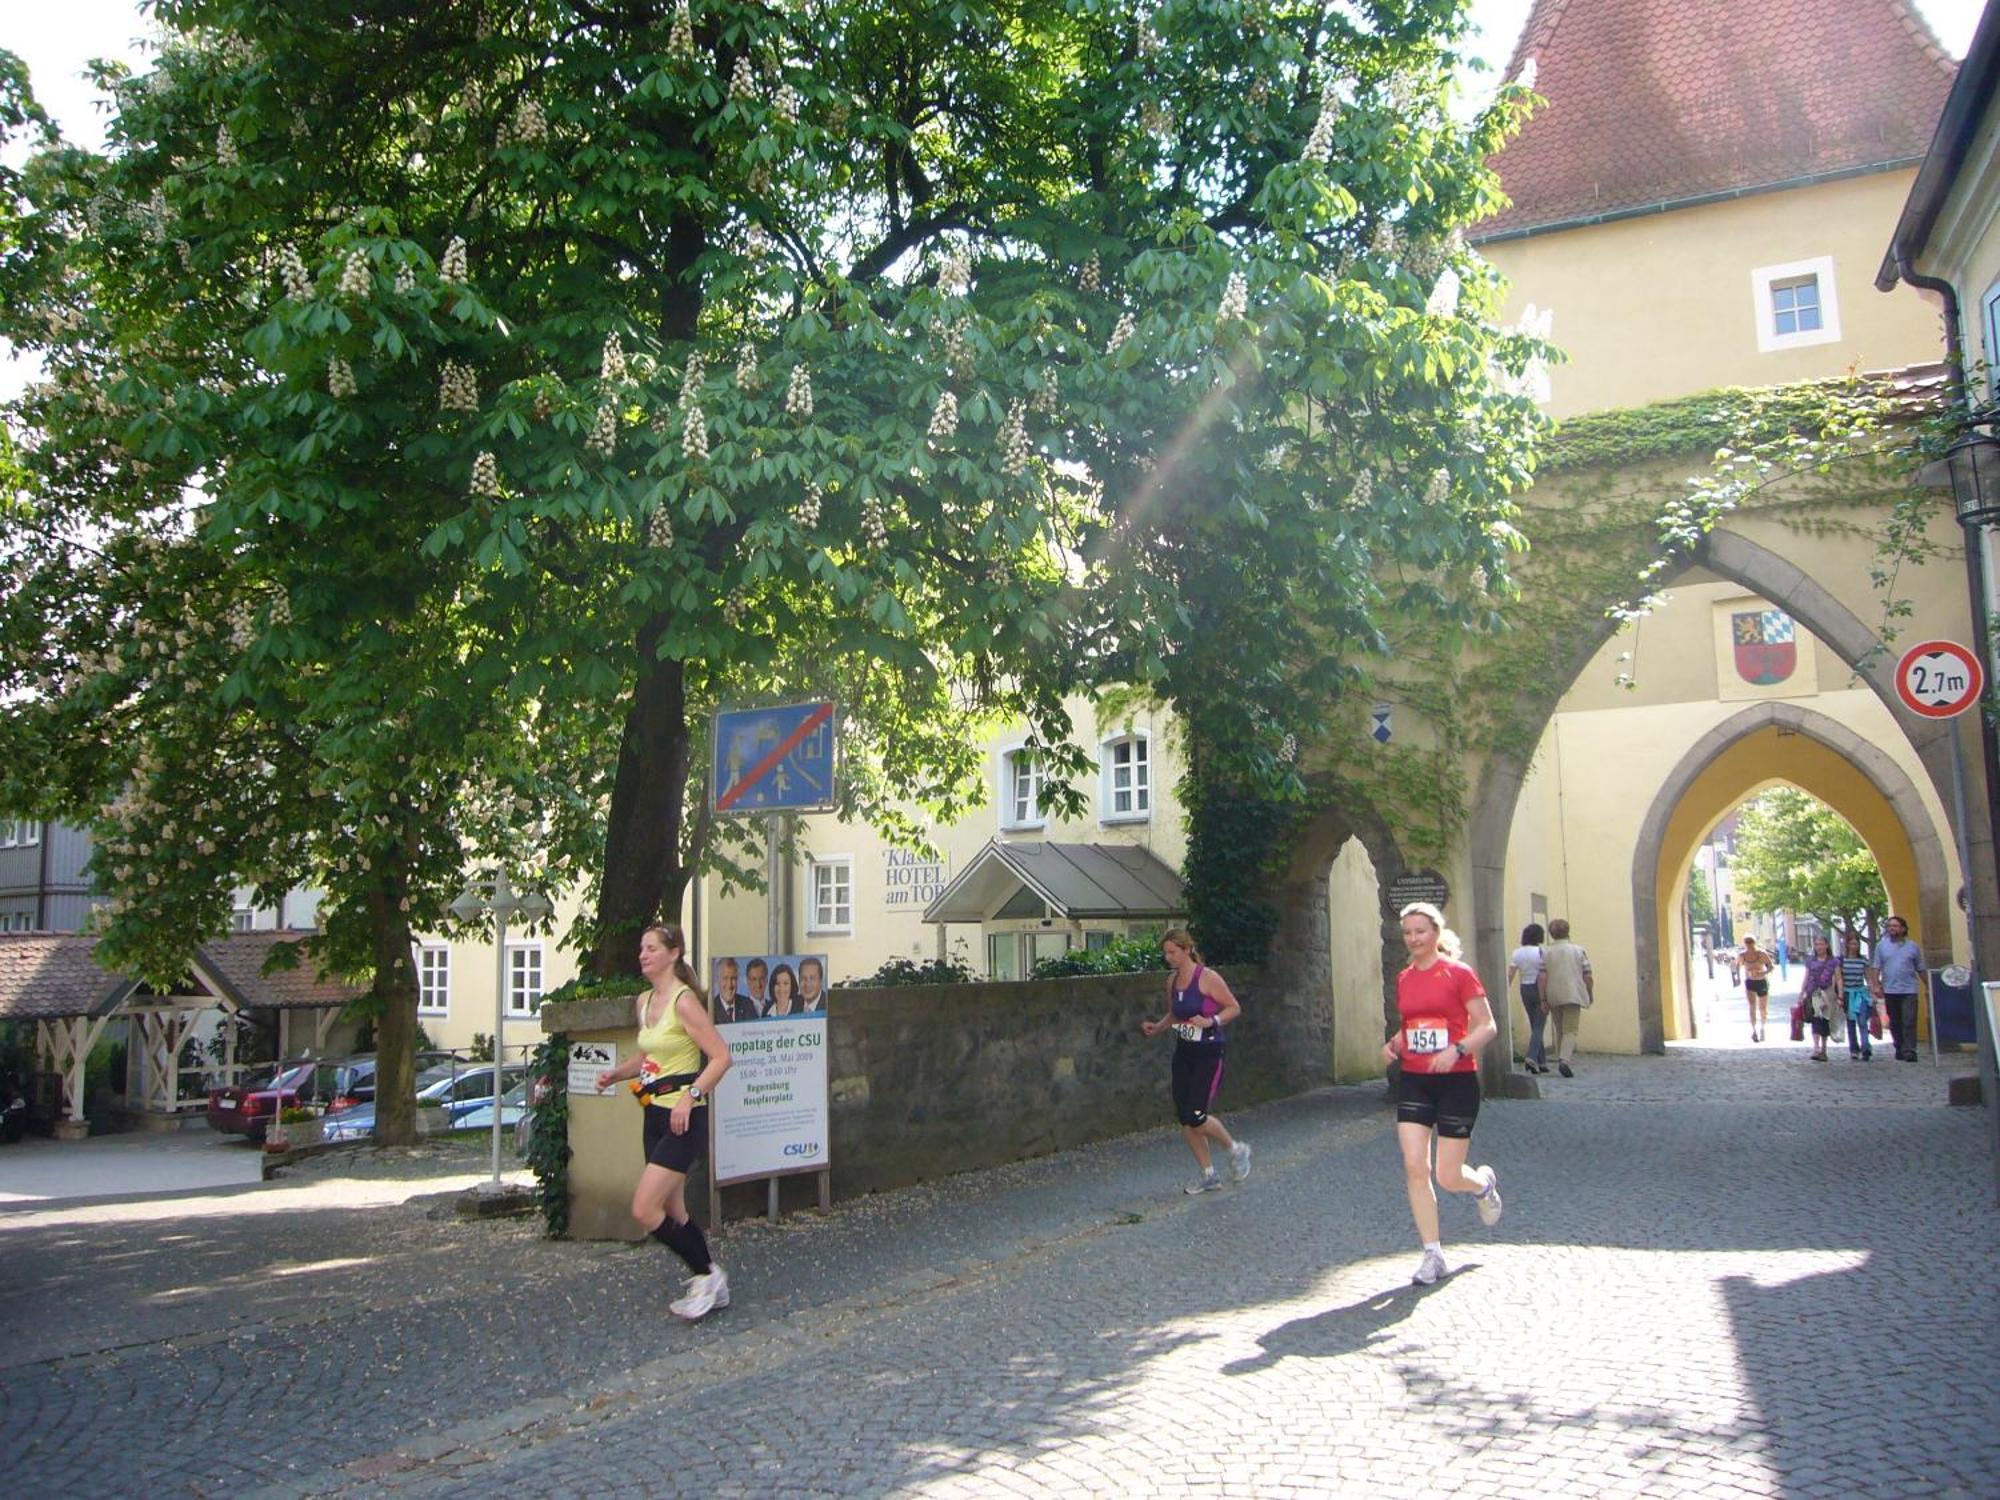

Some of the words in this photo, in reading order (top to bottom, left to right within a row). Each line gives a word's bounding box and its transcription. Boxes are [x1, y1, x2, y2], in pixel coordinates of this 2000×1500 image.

[1912, 666, 1964, 694] 2.7m
[886, 866, 946, 886] HOTEL
[886, 891, 909, 904] am
[729, 1039, 773, 1055] ropatag
[776, 1035, 795, 1049] der
[798, 1032, 821, 1047] CSU
[1413, 1031, 1437, 1048] 454
[747, 1081, 790, 1093] Regensburg
[784, 1143, 807, 1156] CSU
